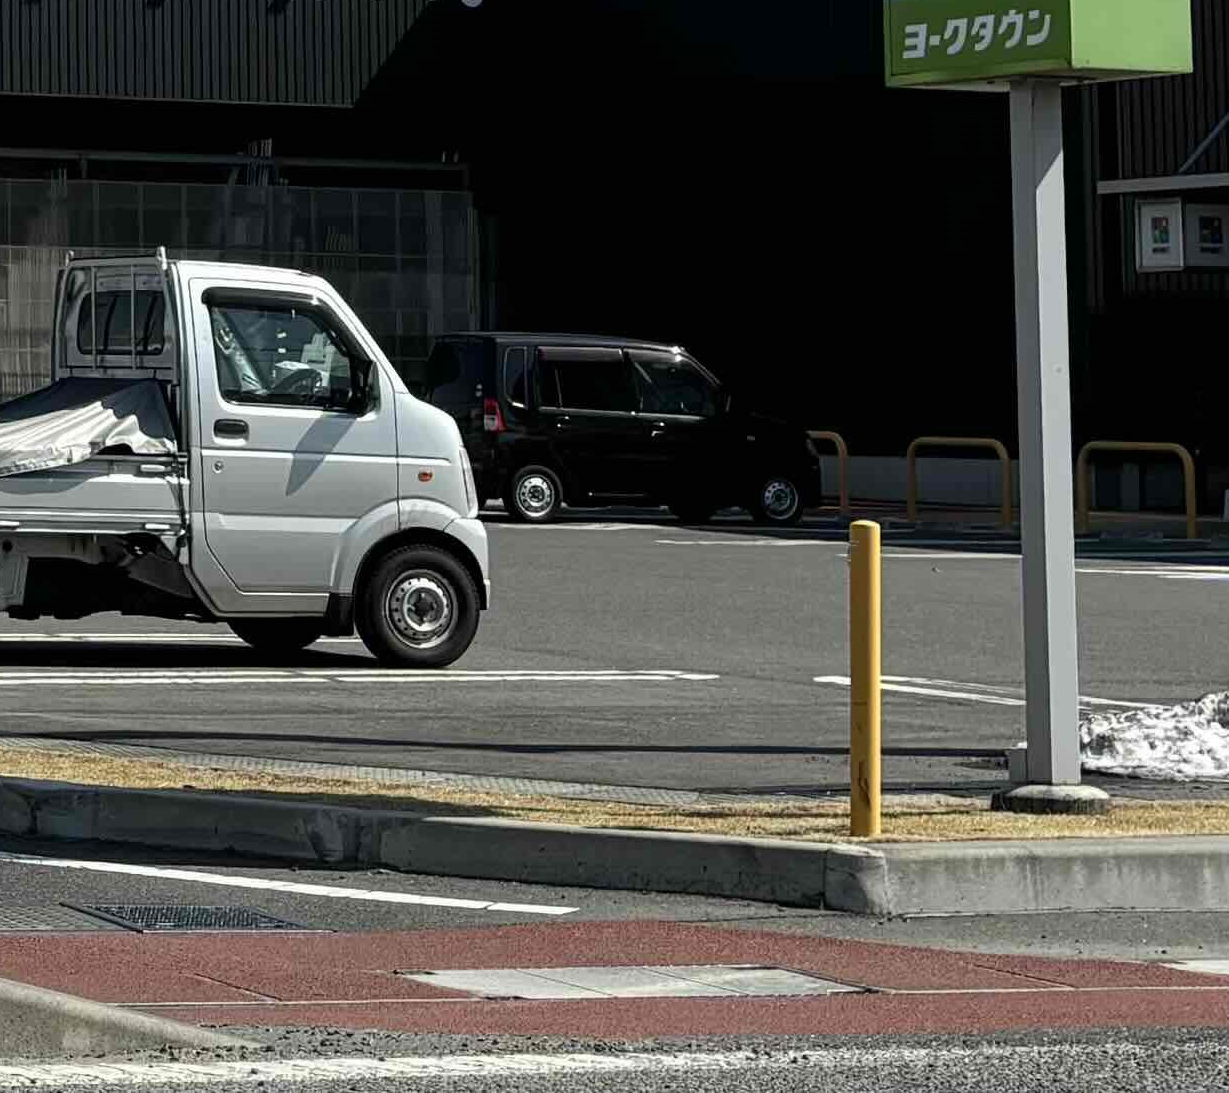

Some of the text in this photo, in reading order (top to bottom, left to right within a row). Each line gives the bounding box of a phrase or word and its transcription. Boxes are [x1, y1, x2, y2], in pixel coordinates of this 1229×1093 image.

[902, 8, 1051, 60] ヨークタウン
